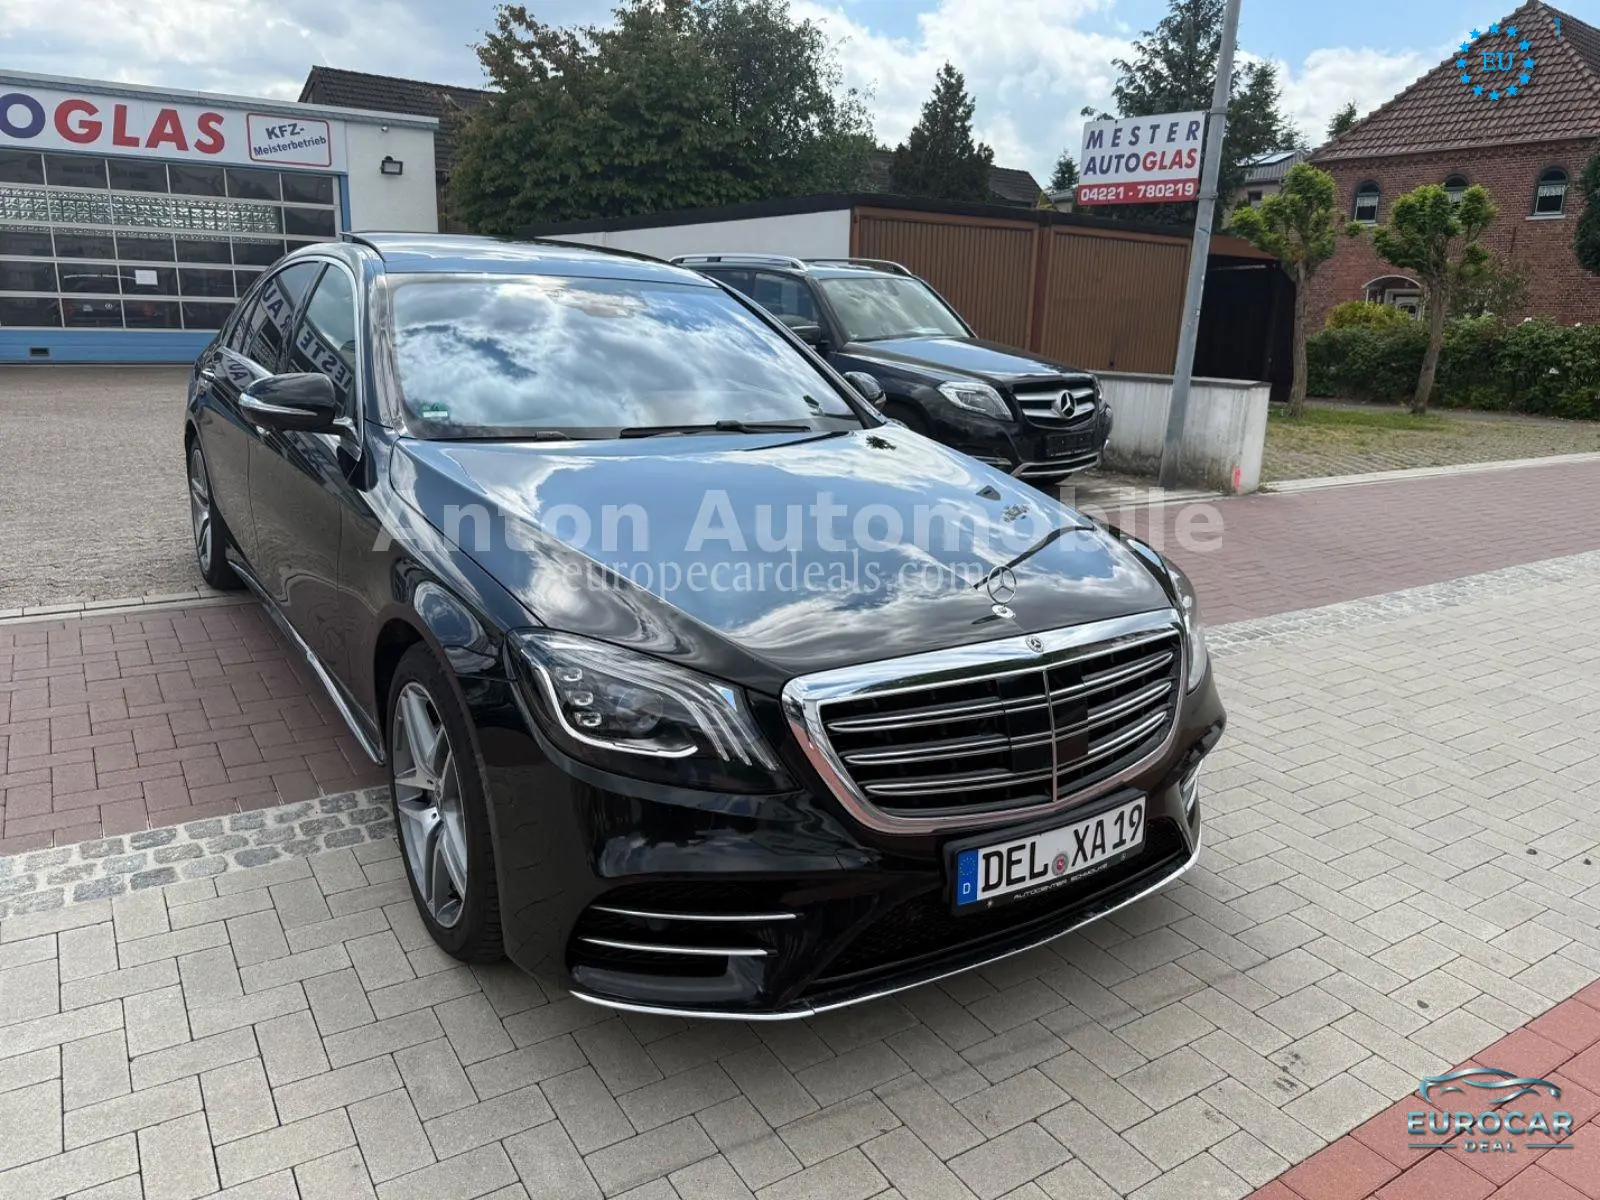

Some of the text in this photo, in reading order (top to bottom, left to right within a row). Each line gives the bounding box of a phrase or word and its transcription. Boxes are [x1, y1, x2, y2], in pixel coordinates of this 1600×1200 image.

[266, 122, 305, 140] KFZ-
[1085, 120, 1201, 150] MESTER
[254, 136, 327, 156] Meisterbetrieb
[1083, 148, 1198, 176] AUTOGLAS
[1081, 186, 1125, 201] 04221
[1136, 182, 1195, 198] 780219
[981, 842, 1049, 893] DEL
[963, 882, 970, 895] D
